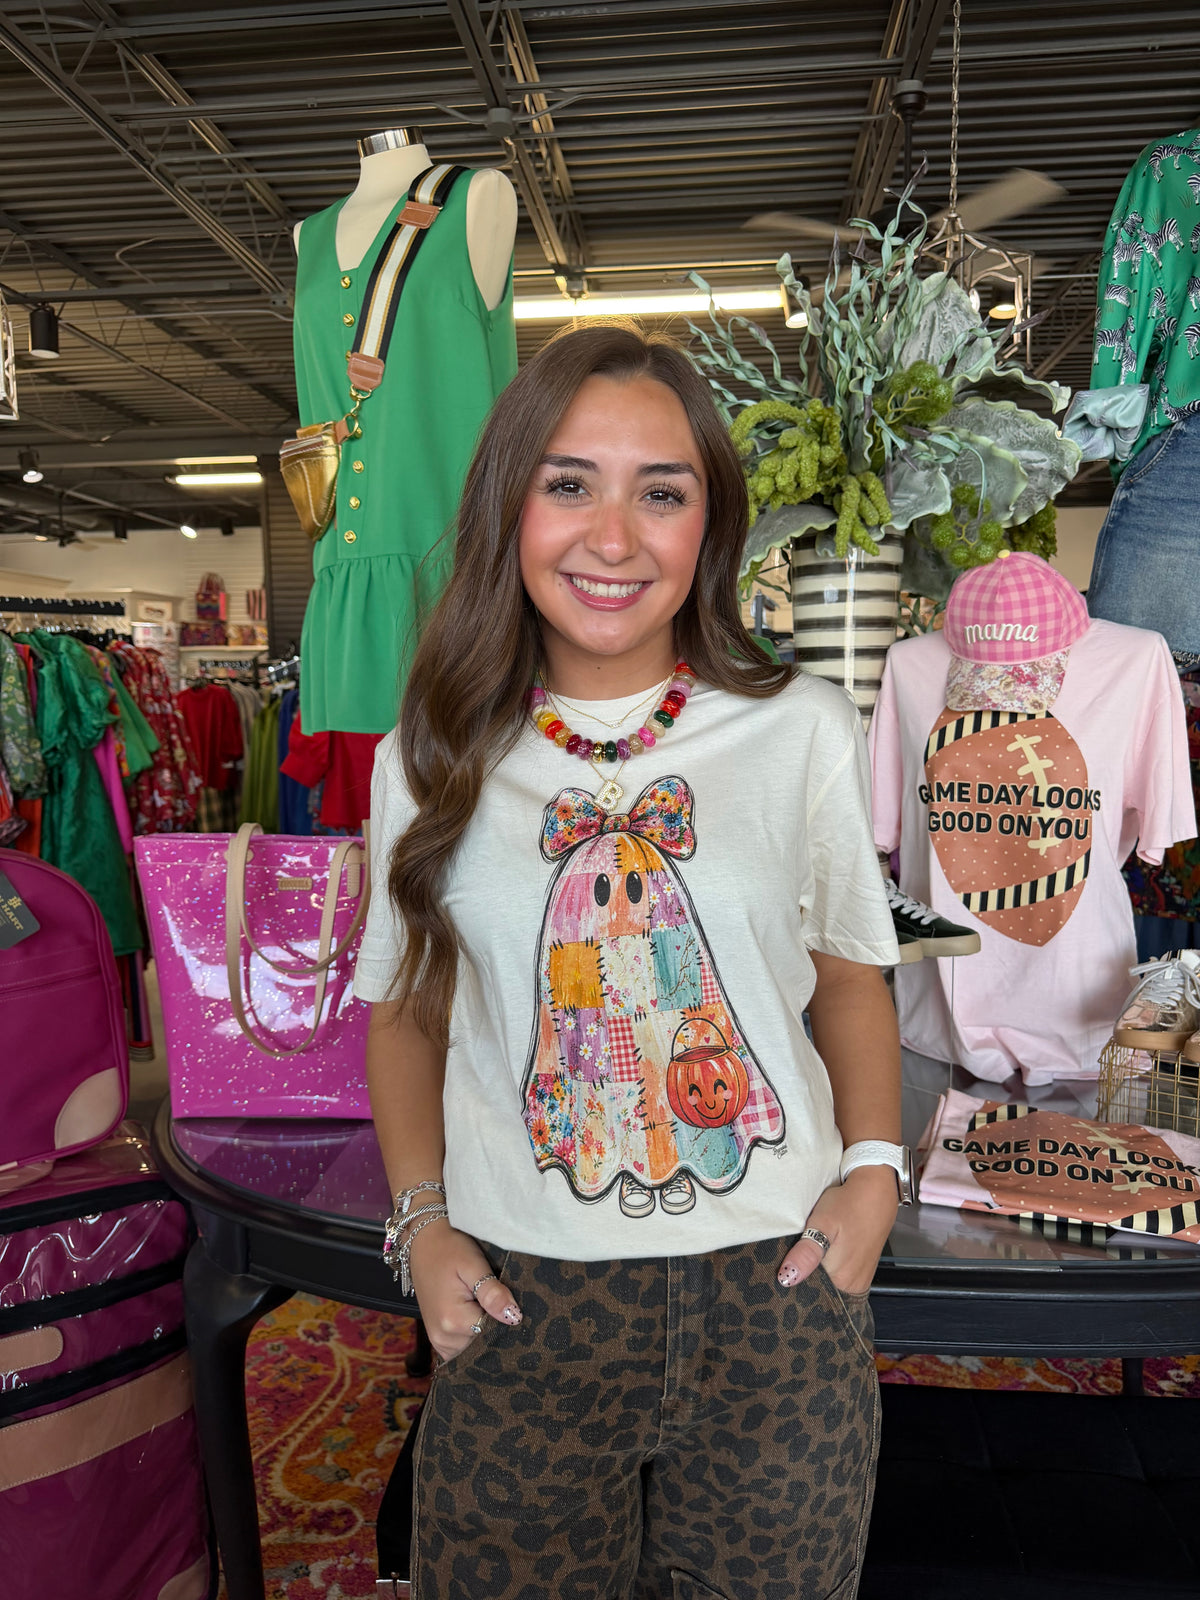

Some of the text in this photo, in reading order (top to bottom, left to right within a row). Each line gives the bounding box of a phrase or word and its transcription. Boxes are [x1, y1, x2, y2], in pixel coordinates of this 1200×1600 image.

[964, 623, 1040, 644] mama
[918, 781, 1101, 811] GAME DAY LOOKS
[928, 811, 1089, 840] GOOD ON YOU
[942, 1138, 1200, 1177] GAME DAY LOOK
[969, 1158, 1194, 1192] GOOD ON YOU
